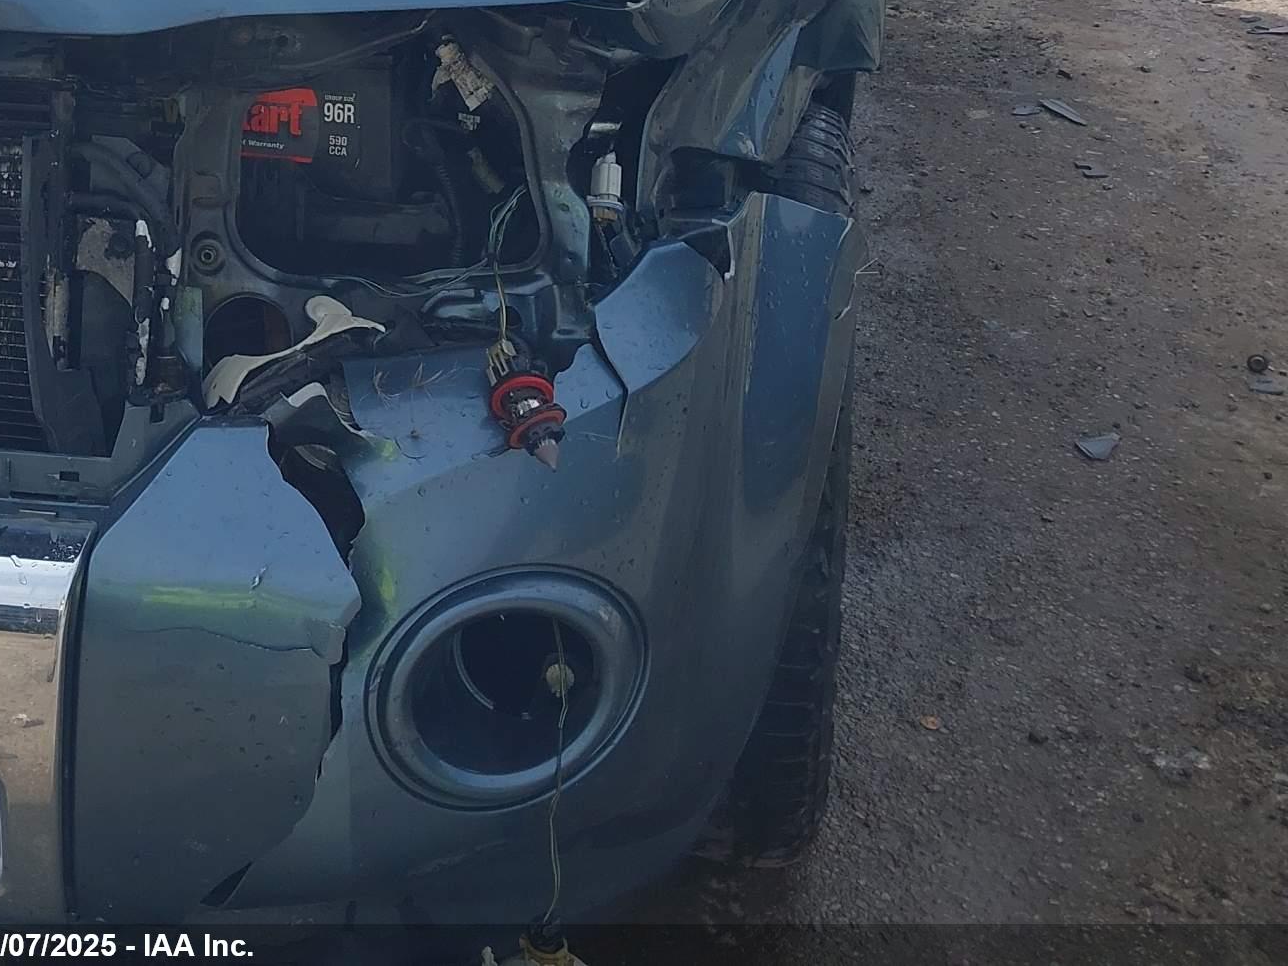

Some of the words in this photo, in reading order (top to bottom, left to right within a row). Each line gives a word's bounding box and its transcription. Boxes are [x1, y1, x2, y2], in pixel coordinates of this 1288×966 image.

[323, 102, 355, 124] 96R
[248, 139, 285, 150] Warranty
[328, 135, 348, 146] 590
[328, 146, 348, 156] CCA
